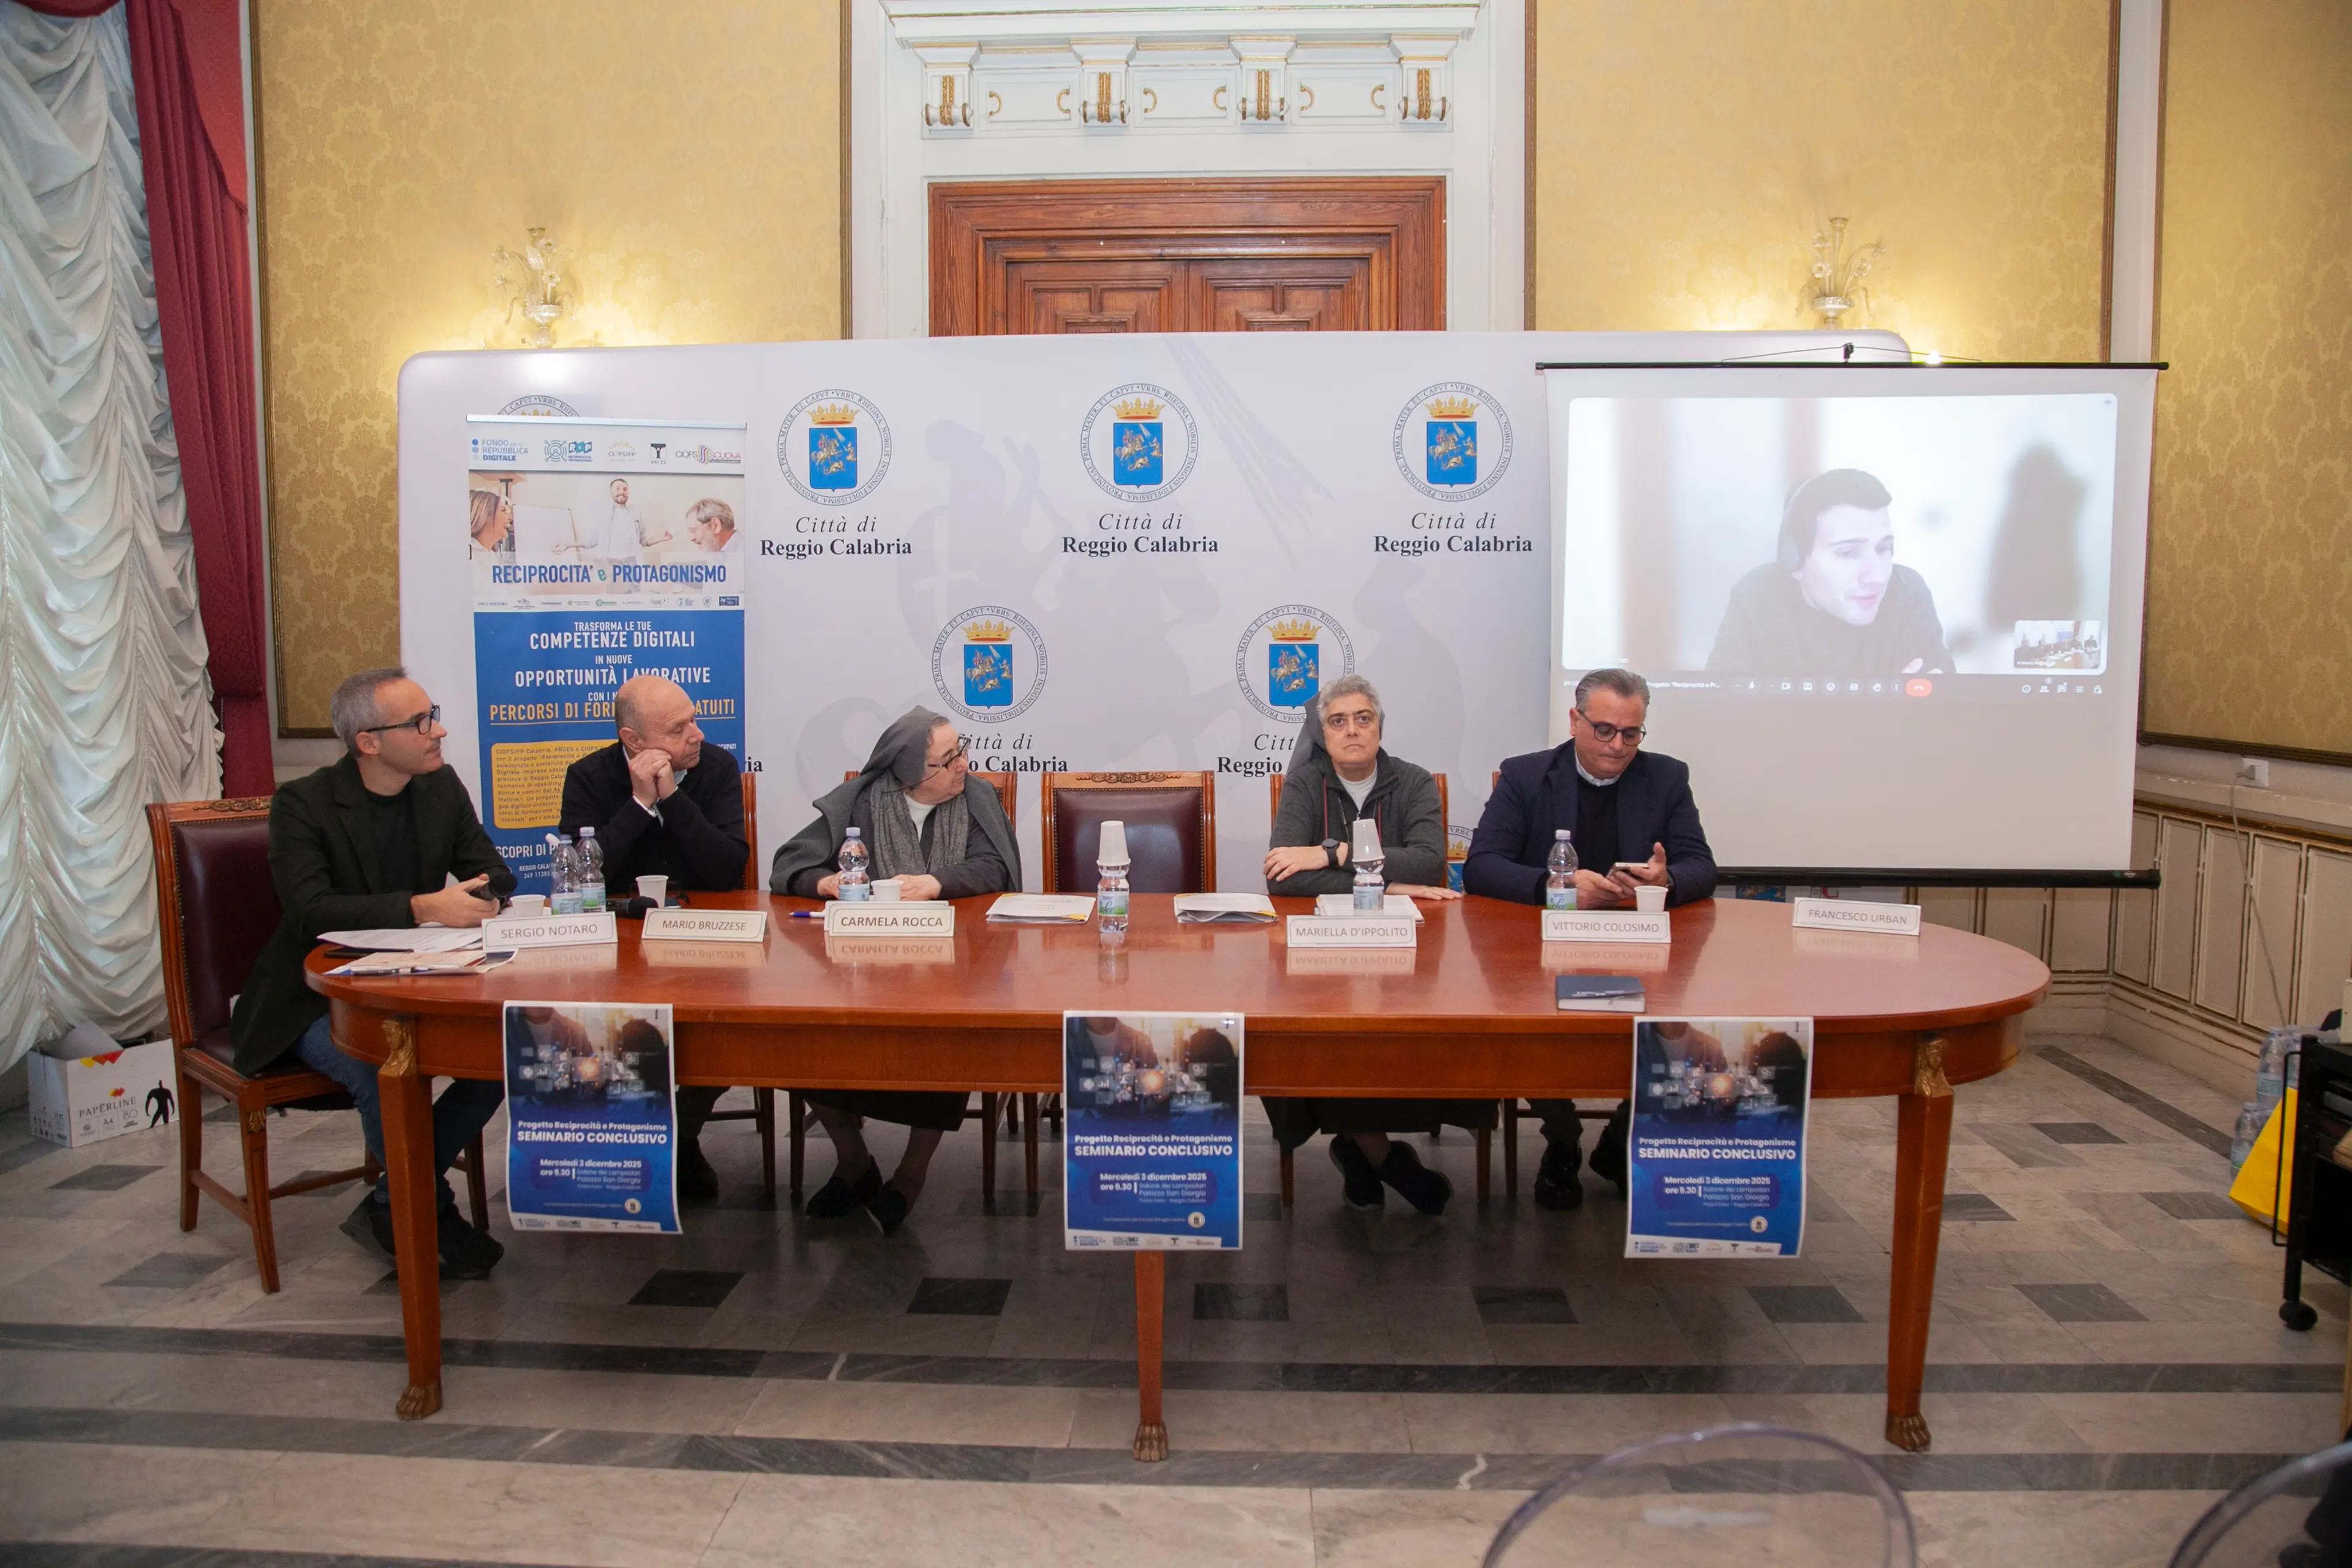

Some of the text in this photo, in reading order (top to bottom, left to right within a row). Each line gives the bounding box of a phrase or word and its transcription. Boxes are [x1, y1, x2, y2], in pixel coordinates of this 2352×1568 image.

[796, 516, 876, 533] Città di
[1099, 513, 1182, 530] Città di
[1412, 512, 1496, 529] Città di
[760, 538, 912, 560] Reggio Calabria
[1062, 536, 1218, 557] Reggio Calabria
[1374, 535, 1532, 556] Reggio Calabria
[598, 568, 606, 581] e
[613, 565, 726, 583] PROTAGONISMO
[575, 622, 652, 631] TRASFORMA LE TUE
[530, 630, 695, 649] COMPETENZE DIGITALI
[595, 655, 633, 665] IN NUOVE
[515, 666, 617, 687] OPPORTUNITÀ
[588, 693, 605, 701] CON
[491, 703, 559, 720] PERCORSI
[565, 703, 579, 718] DI
[1012, 733, 1031, 749] di
[986, 756, 1068, 772] Calabria
[1217, 757, 1283, 777] Reggio
[536, 844, 546, 856] DI
[841, 917, 943, 927] CARMELA ROCCA
[1809, 910, 1907, 924] FRANCESCO URBAN
[501, 924, 598, 939] SERGIO NOTARO
[662, 920, 746, 931] MARIO BRUZZESE
[1296, 927, 1346, 937] MARIELLA
[1553, 921, 1659, 932] VITTORIO COLOSIMO
[79, 1097, 137, 1118] PAPERLINE
[123, 1109, 138, 1120] 80
[518, 1121, 554, 1130] Progetto
[554, 1121, 601, 1131] Reciprocità
[608, 1123, 666, 1131] Protagonismo
[518, 1131, 667, 1144] SEMINARIO CONCLUSIVO
[1075, 1135, 1112, 1145] Progetto
[1114, 1134, 1163, 1144] Reciprocità
[1171, 1134, 1232, 1144] Protagonismo
[1639, 1138, 1676, 1147] Progetto
[1678, 1137, 1726, 1147] Reciprocità
[1735, 1138, 1796, 1147] Protagonismo
[1075, 1145, 1232, 1156] SEMINARIO CONCLUSIVO
[1639, 1148, 1796, 1159] SEMINARIO CONCLUSIVO
